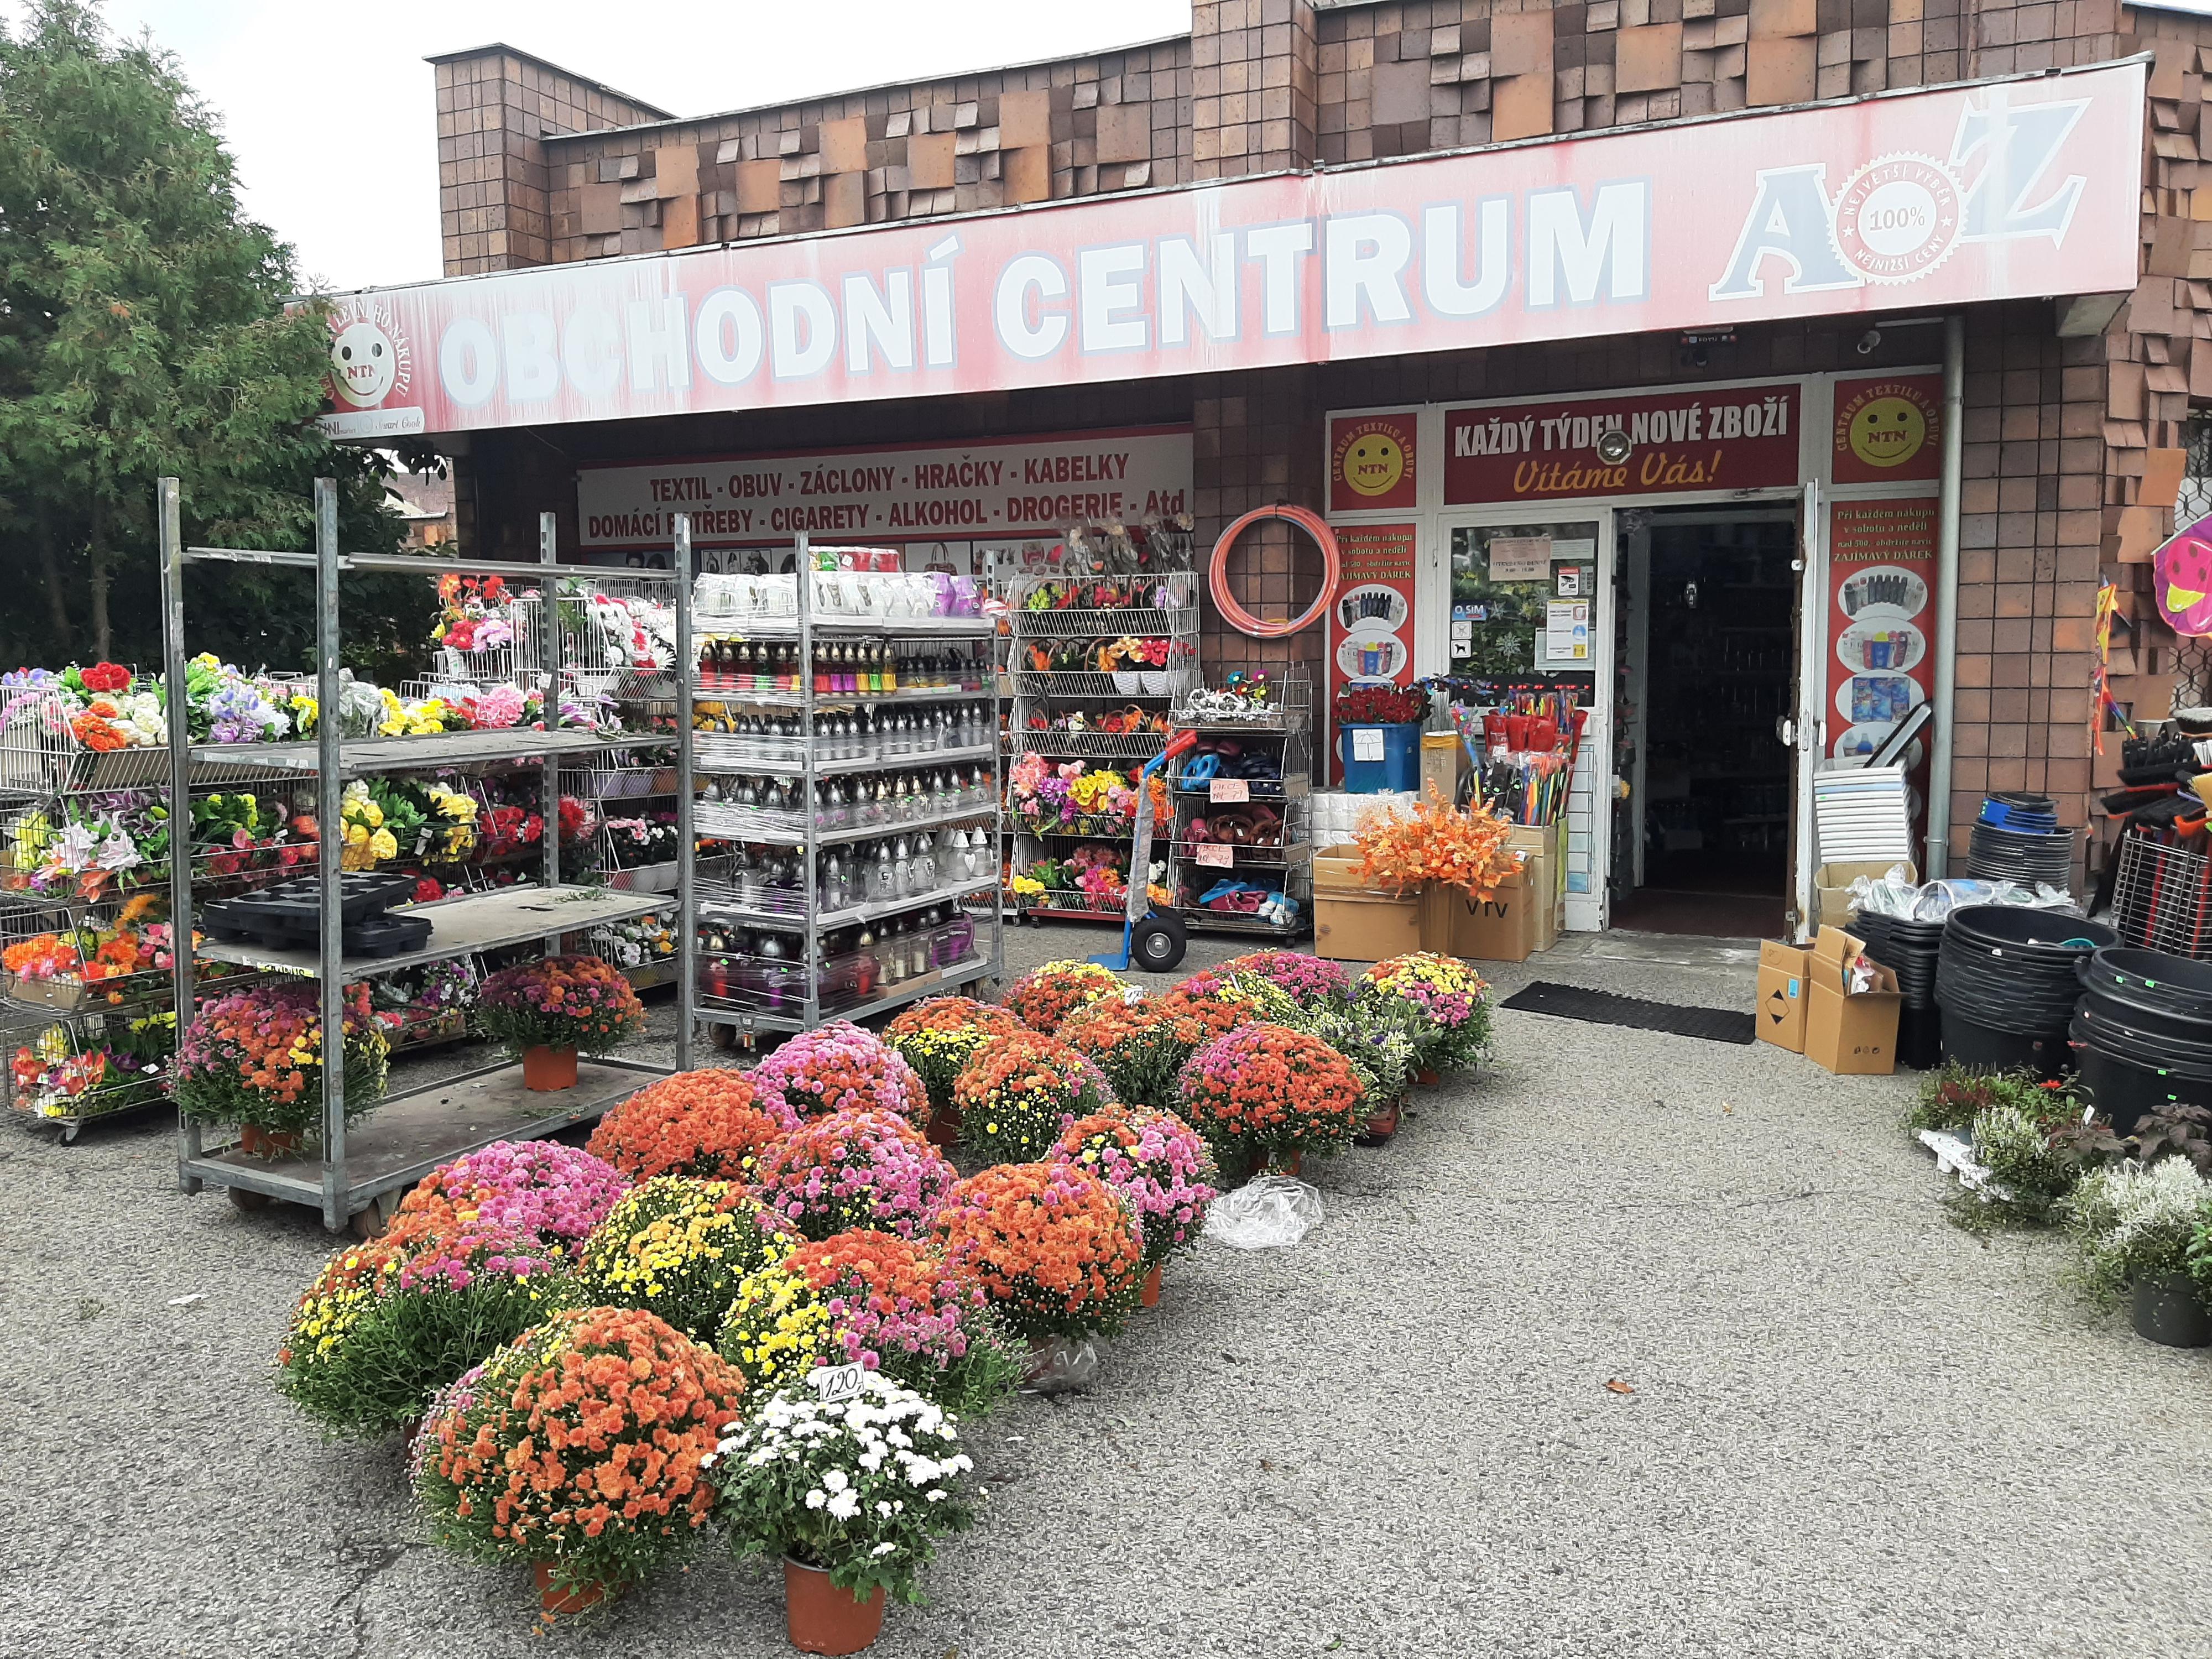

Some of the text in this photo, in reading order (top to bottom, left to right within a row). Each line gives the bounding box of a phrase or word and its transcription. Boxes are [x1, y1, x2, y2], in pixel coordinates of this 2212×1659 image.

[1708, 97, 2093, 301] A Z
[1915, 168, 1952, 206] VÝBĚR
[1870, 205, 1926, 231] 100%
[1914, 234, 1944, 263] CENY
[439, 233, 963, 410] OBCHODNÍ
[995, 176, 1651, 363] CENTRUM
[347, 364, 378, 379] NTN
[1866, 385, 1922, 401] TEXTILU
[1355, 422, 1400, 437] TEXTILU
[1455, 416, 1535, 457] KAŽDÝ
[1632, 403, 1702, 445] NOVÉ
[1708, 395, 1790, 440] ZBOŽÍ
[1868, 430, 1907, 443] NTN
[650, 453, 1130, 502] TEXTIL OBUV ZÁCLONY HRAČKY KABELKY
[1358, 463, 1389, 475] NTN
[1514, 450, 1724, 493] Vítáme Vás!
[589, 488, 1185, 538] DOMÁCÍ PTŘEBY CIGARETY ALKOHOL DROGERIE Atd
[1853, 524, 1885, 533] sobotu
[1339, 571, 1378, 580] AJÍMAVÝ
